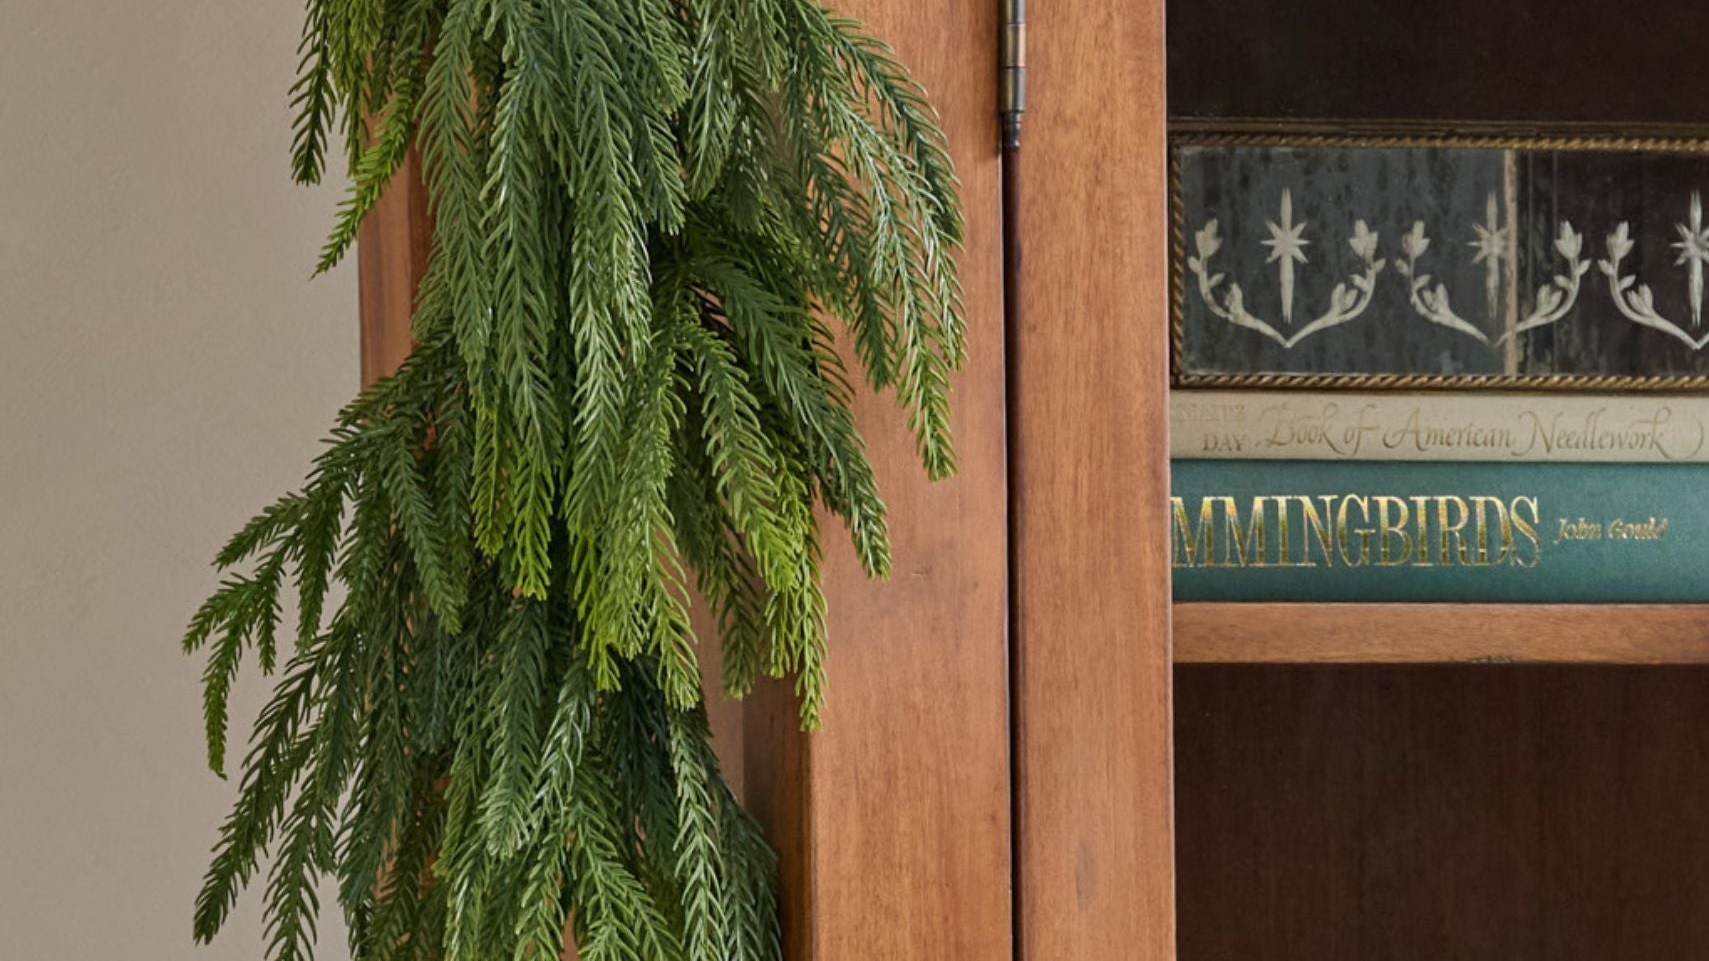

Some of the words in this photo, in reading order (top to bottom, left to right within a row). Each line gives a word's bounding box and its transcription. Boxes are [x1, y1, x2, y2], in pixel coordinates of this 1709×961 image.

[1202, 432, 1248, 452] DAY
[1256, 402, 1347, 456] Book
[1343, 403, 1380, 458] of
[1382, 407, 1516, 452] American
[1511, 406, 1704, 460] Needlework
[1553, 516, 1603, 545] John
